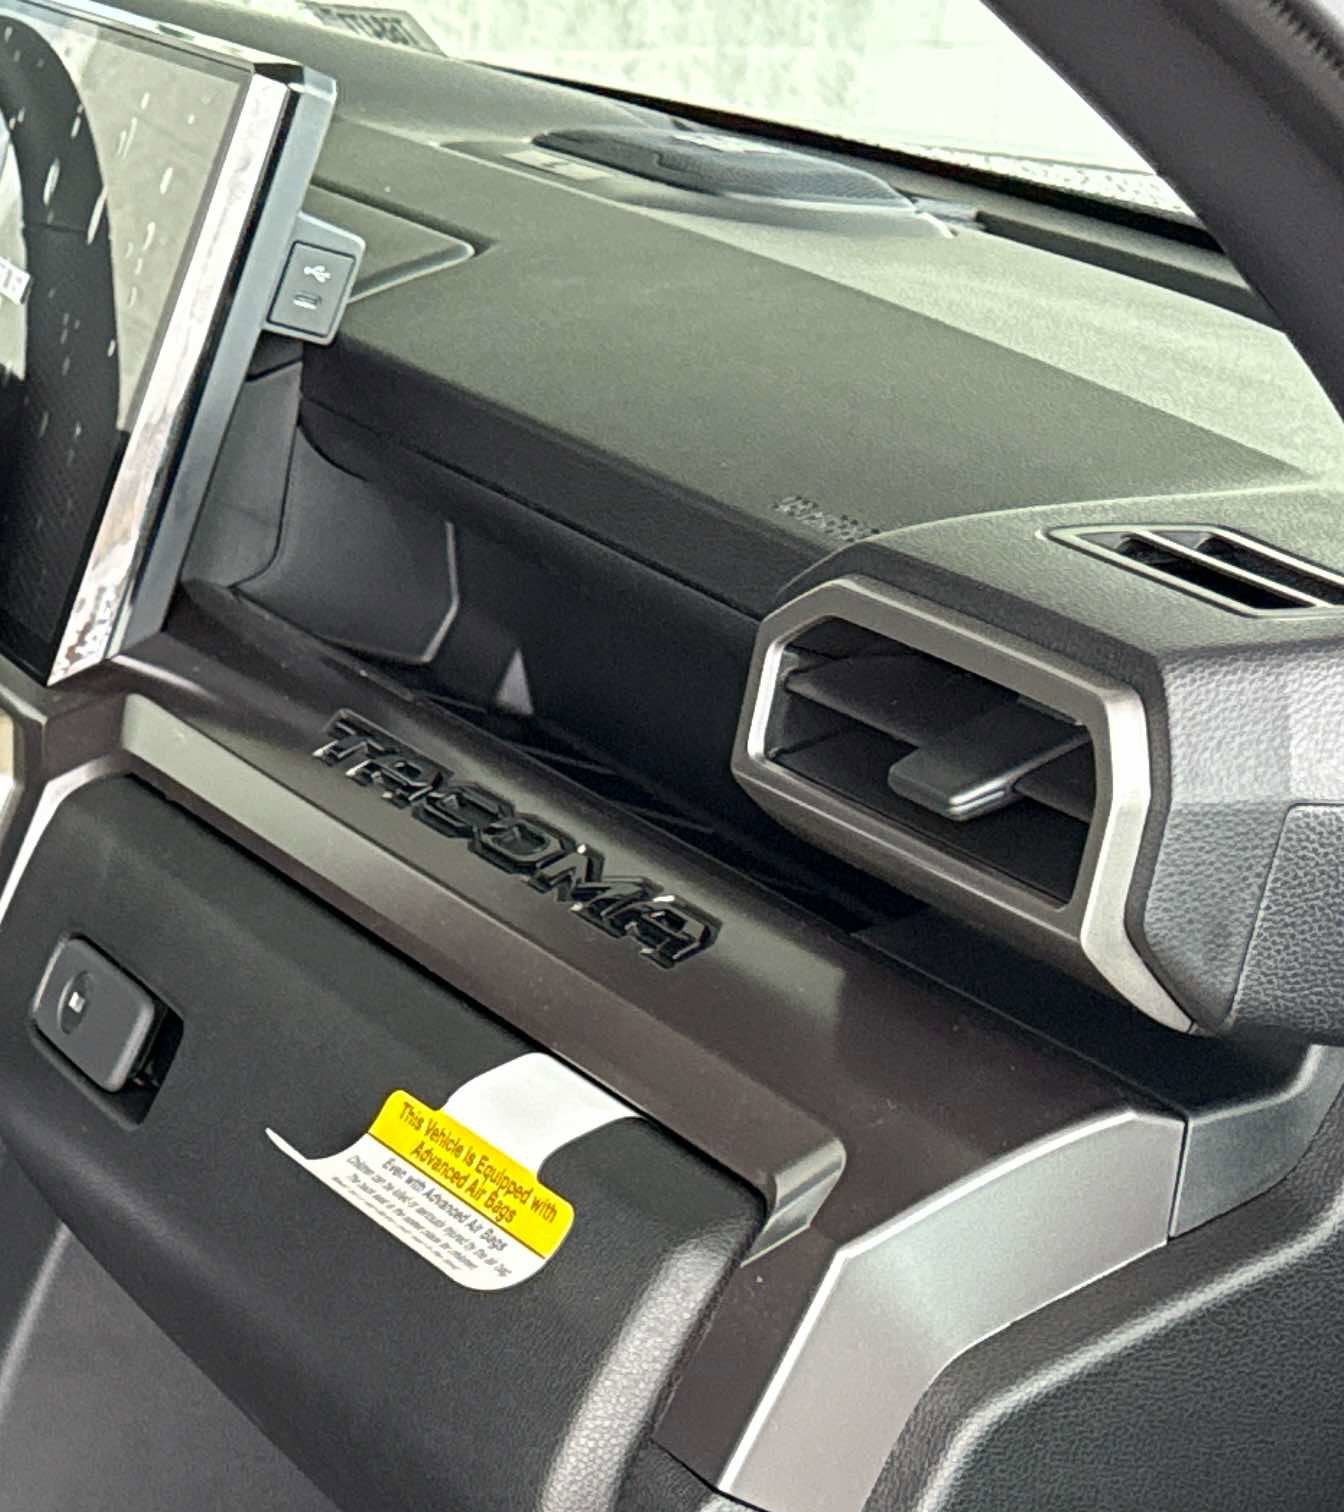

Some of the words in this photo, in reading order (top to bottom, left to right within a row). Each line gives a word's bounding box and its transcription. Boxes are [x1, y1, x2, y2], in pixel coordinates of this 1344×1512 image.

[313, 708, 723, 969] TACOMA
[399, 1101, 425, 1132] This
[424, 1118, 464, 1159] Vehicle
[462, 1146, 477, 1167] is
[474, 1154, 534, 1205] Equipped
[530, 1196, 559, 1224] with
[410, 1140, 471, 1190] Advanced
[464, 1178, 488, 1202] Air
[483, 1190, 518, 1224] Bags
